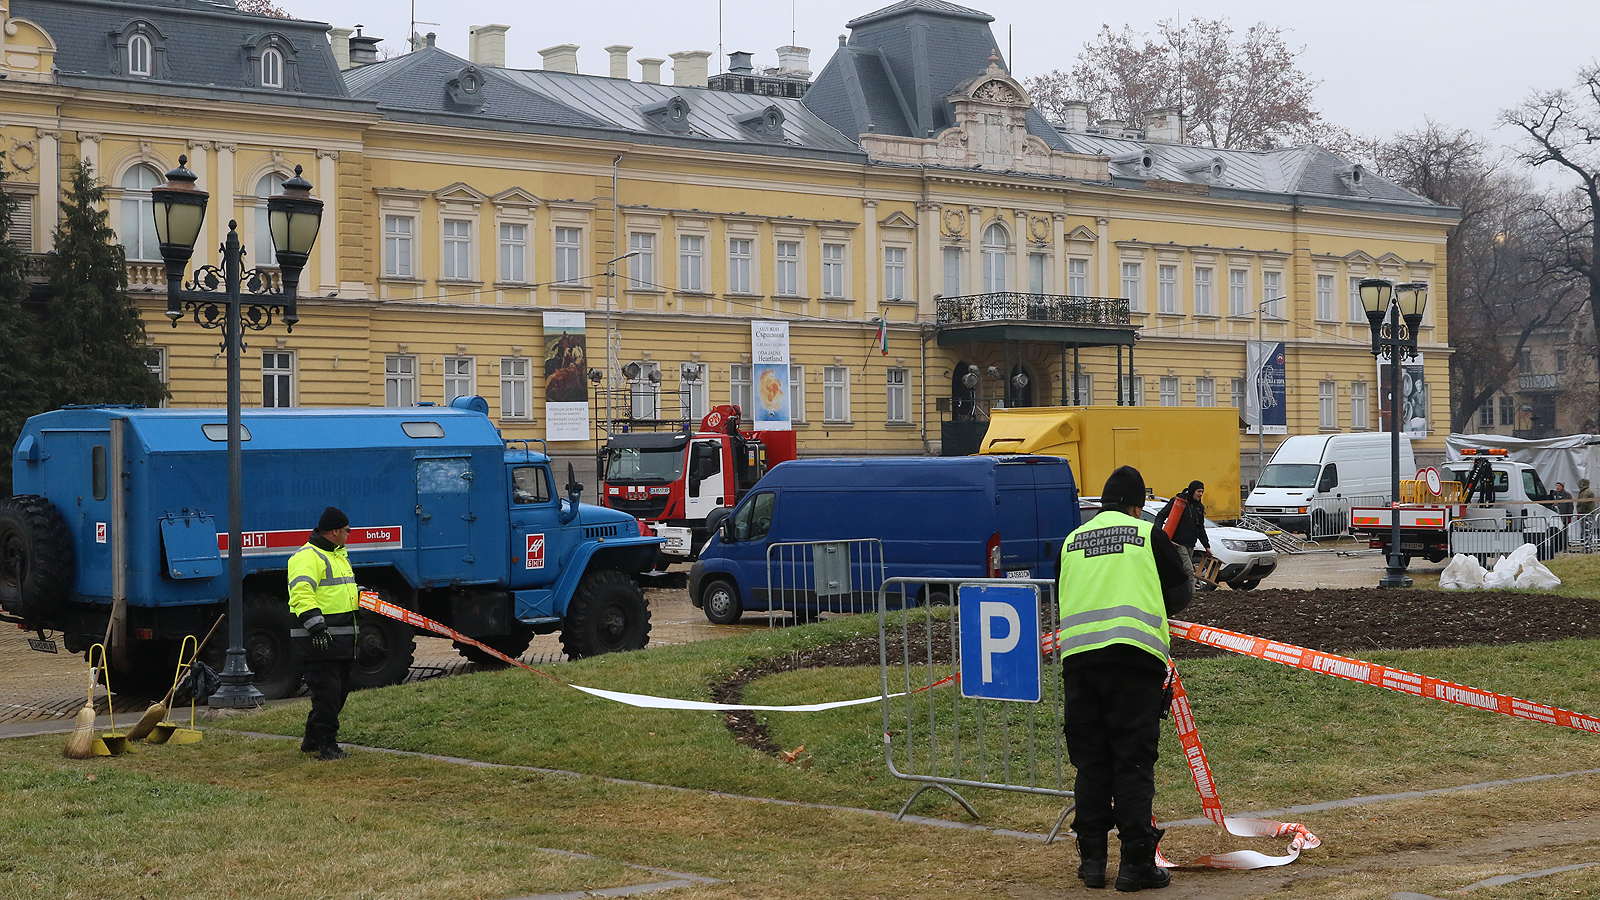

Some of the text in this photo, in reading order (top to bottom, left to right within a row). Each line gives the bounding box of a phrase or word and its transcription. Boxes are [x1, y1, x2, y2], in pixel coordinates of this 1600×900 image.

[709, 413, 721, 427] PM
[625, 492, 649, 500] IVECO
[366, 526, 391, 540] bnt.bg
[1075, 526, 1137, 542] АВАРИЙНО
[1067, 535, 1144, 552] СПАСИТЕЛНО
[1085, 544, 1123, 557] ЗВЕНО
[979, 601, 1021, 683] P
[1199, 628, 1256, 653] НЕ ПРЕМИНАВАЙ!
[1312, 655, 1371, 682] НЕ ПРЕМИНАВАЙ!
[1435, 683, 1499, 711] НЕ ПРЕМИНАВАЙ!
[1569, 715, 1582, 729] НЕ
[1186, 745, 1200, 758] НЕ
